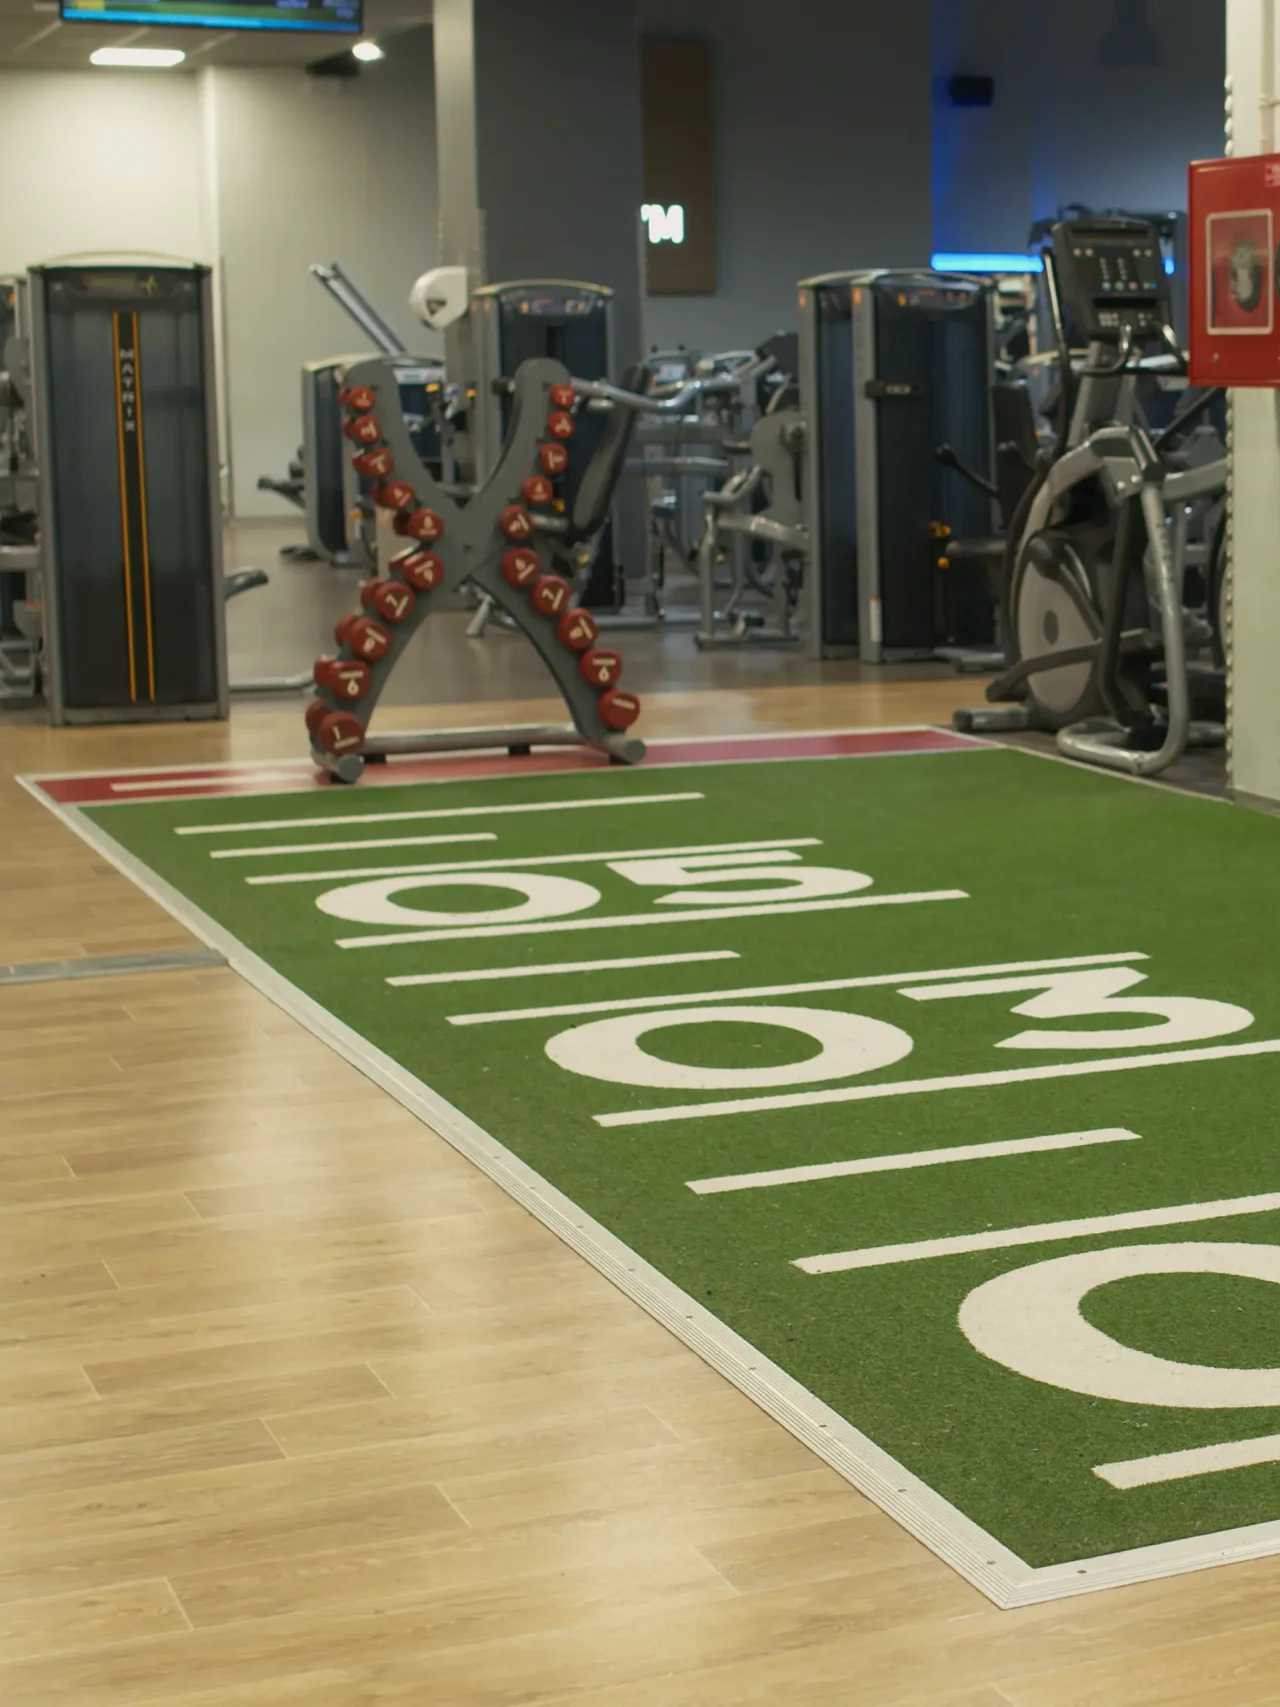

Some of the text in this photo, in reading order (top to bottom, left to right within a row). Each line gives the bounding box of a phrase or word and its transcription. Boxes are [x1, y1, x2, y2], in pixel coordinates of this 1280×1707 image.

[119, 347, 136, 432] MATRIX
[315, 849, 874, 926] 05
[544, 966, 1255, 1089] 03
